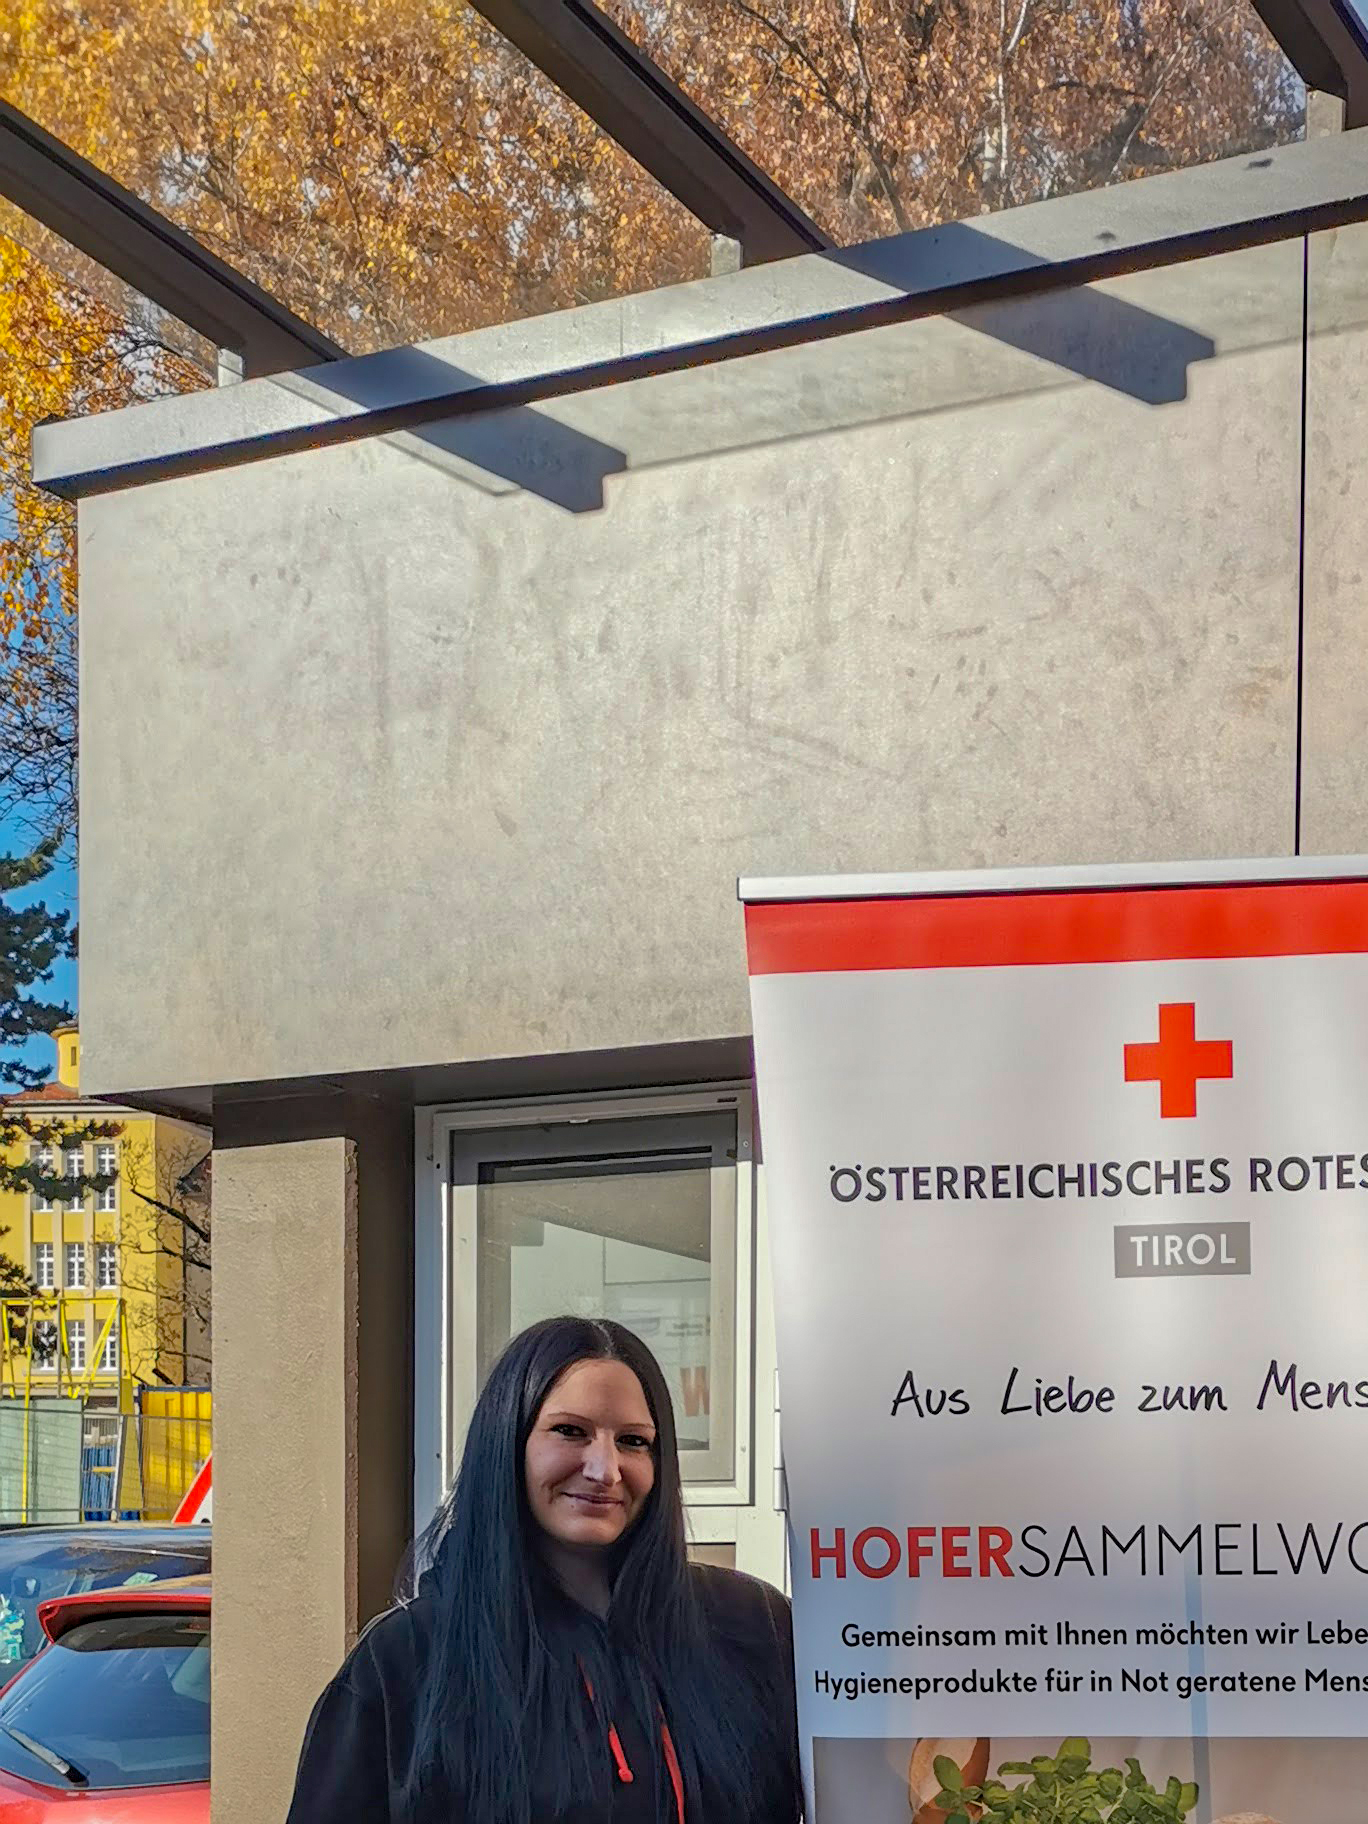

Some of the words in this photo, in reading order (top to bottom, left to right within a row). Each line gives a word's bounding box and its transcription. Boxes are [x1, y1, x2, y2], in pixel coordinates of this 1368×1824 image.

[829, 1157, 1231, 1203] ÖSTERREICHISCHES
[1130, 1233, 1236, 1268] TIROL
[890, 1370, 971, 1419] Aus
[1000, 1366, 1116, 1417] Liebe
[1137, 1384, 1228, 1413] zum
[841, 1623, 996, 1648] Gemeinsam
[1004, 1623, 1049, 1646] mit
[1056, 1620, 1128, 1646] Ihnen
[1135, 1619, 1248, 1646] möchten
[1255, 1621, 1300, 1645] wir
[814, 1668, 1038, 1701] Hygieneprodukte
[1044, 1667, 1084, 1693] für
[1090, 1669, 1113, 1692] in
[1121, 1667, 1169, 1693] Not
[1176, 1671, 1297, 1700] geratene
